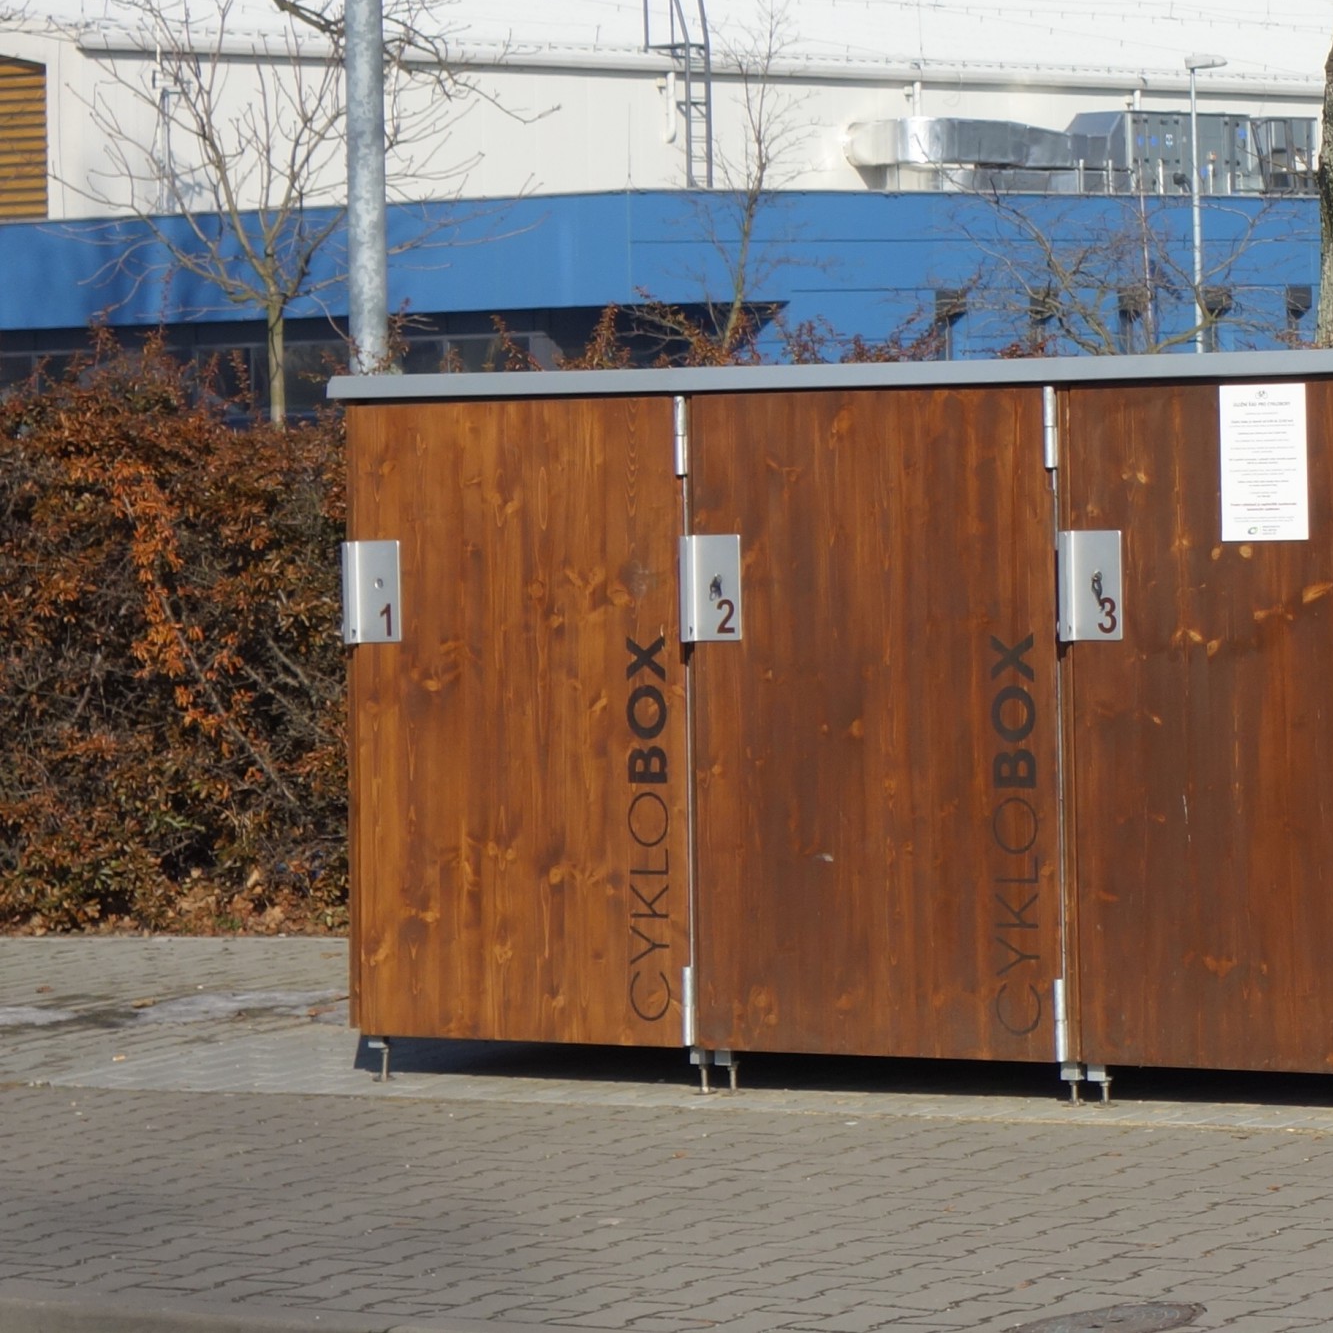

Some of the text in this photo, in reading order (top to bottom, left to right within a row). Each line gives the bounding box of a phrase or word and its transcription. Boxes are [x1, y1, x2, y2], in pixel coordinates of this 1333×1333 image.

[380, 603, 392, 637] 1
[716, 599, 735, 634] 2
[1098, 597, 1117, 634] 3
[626, 636, 671, 1022] CYKLOBOX
[990, 633, 1041, 1036] CYKLOBOX
